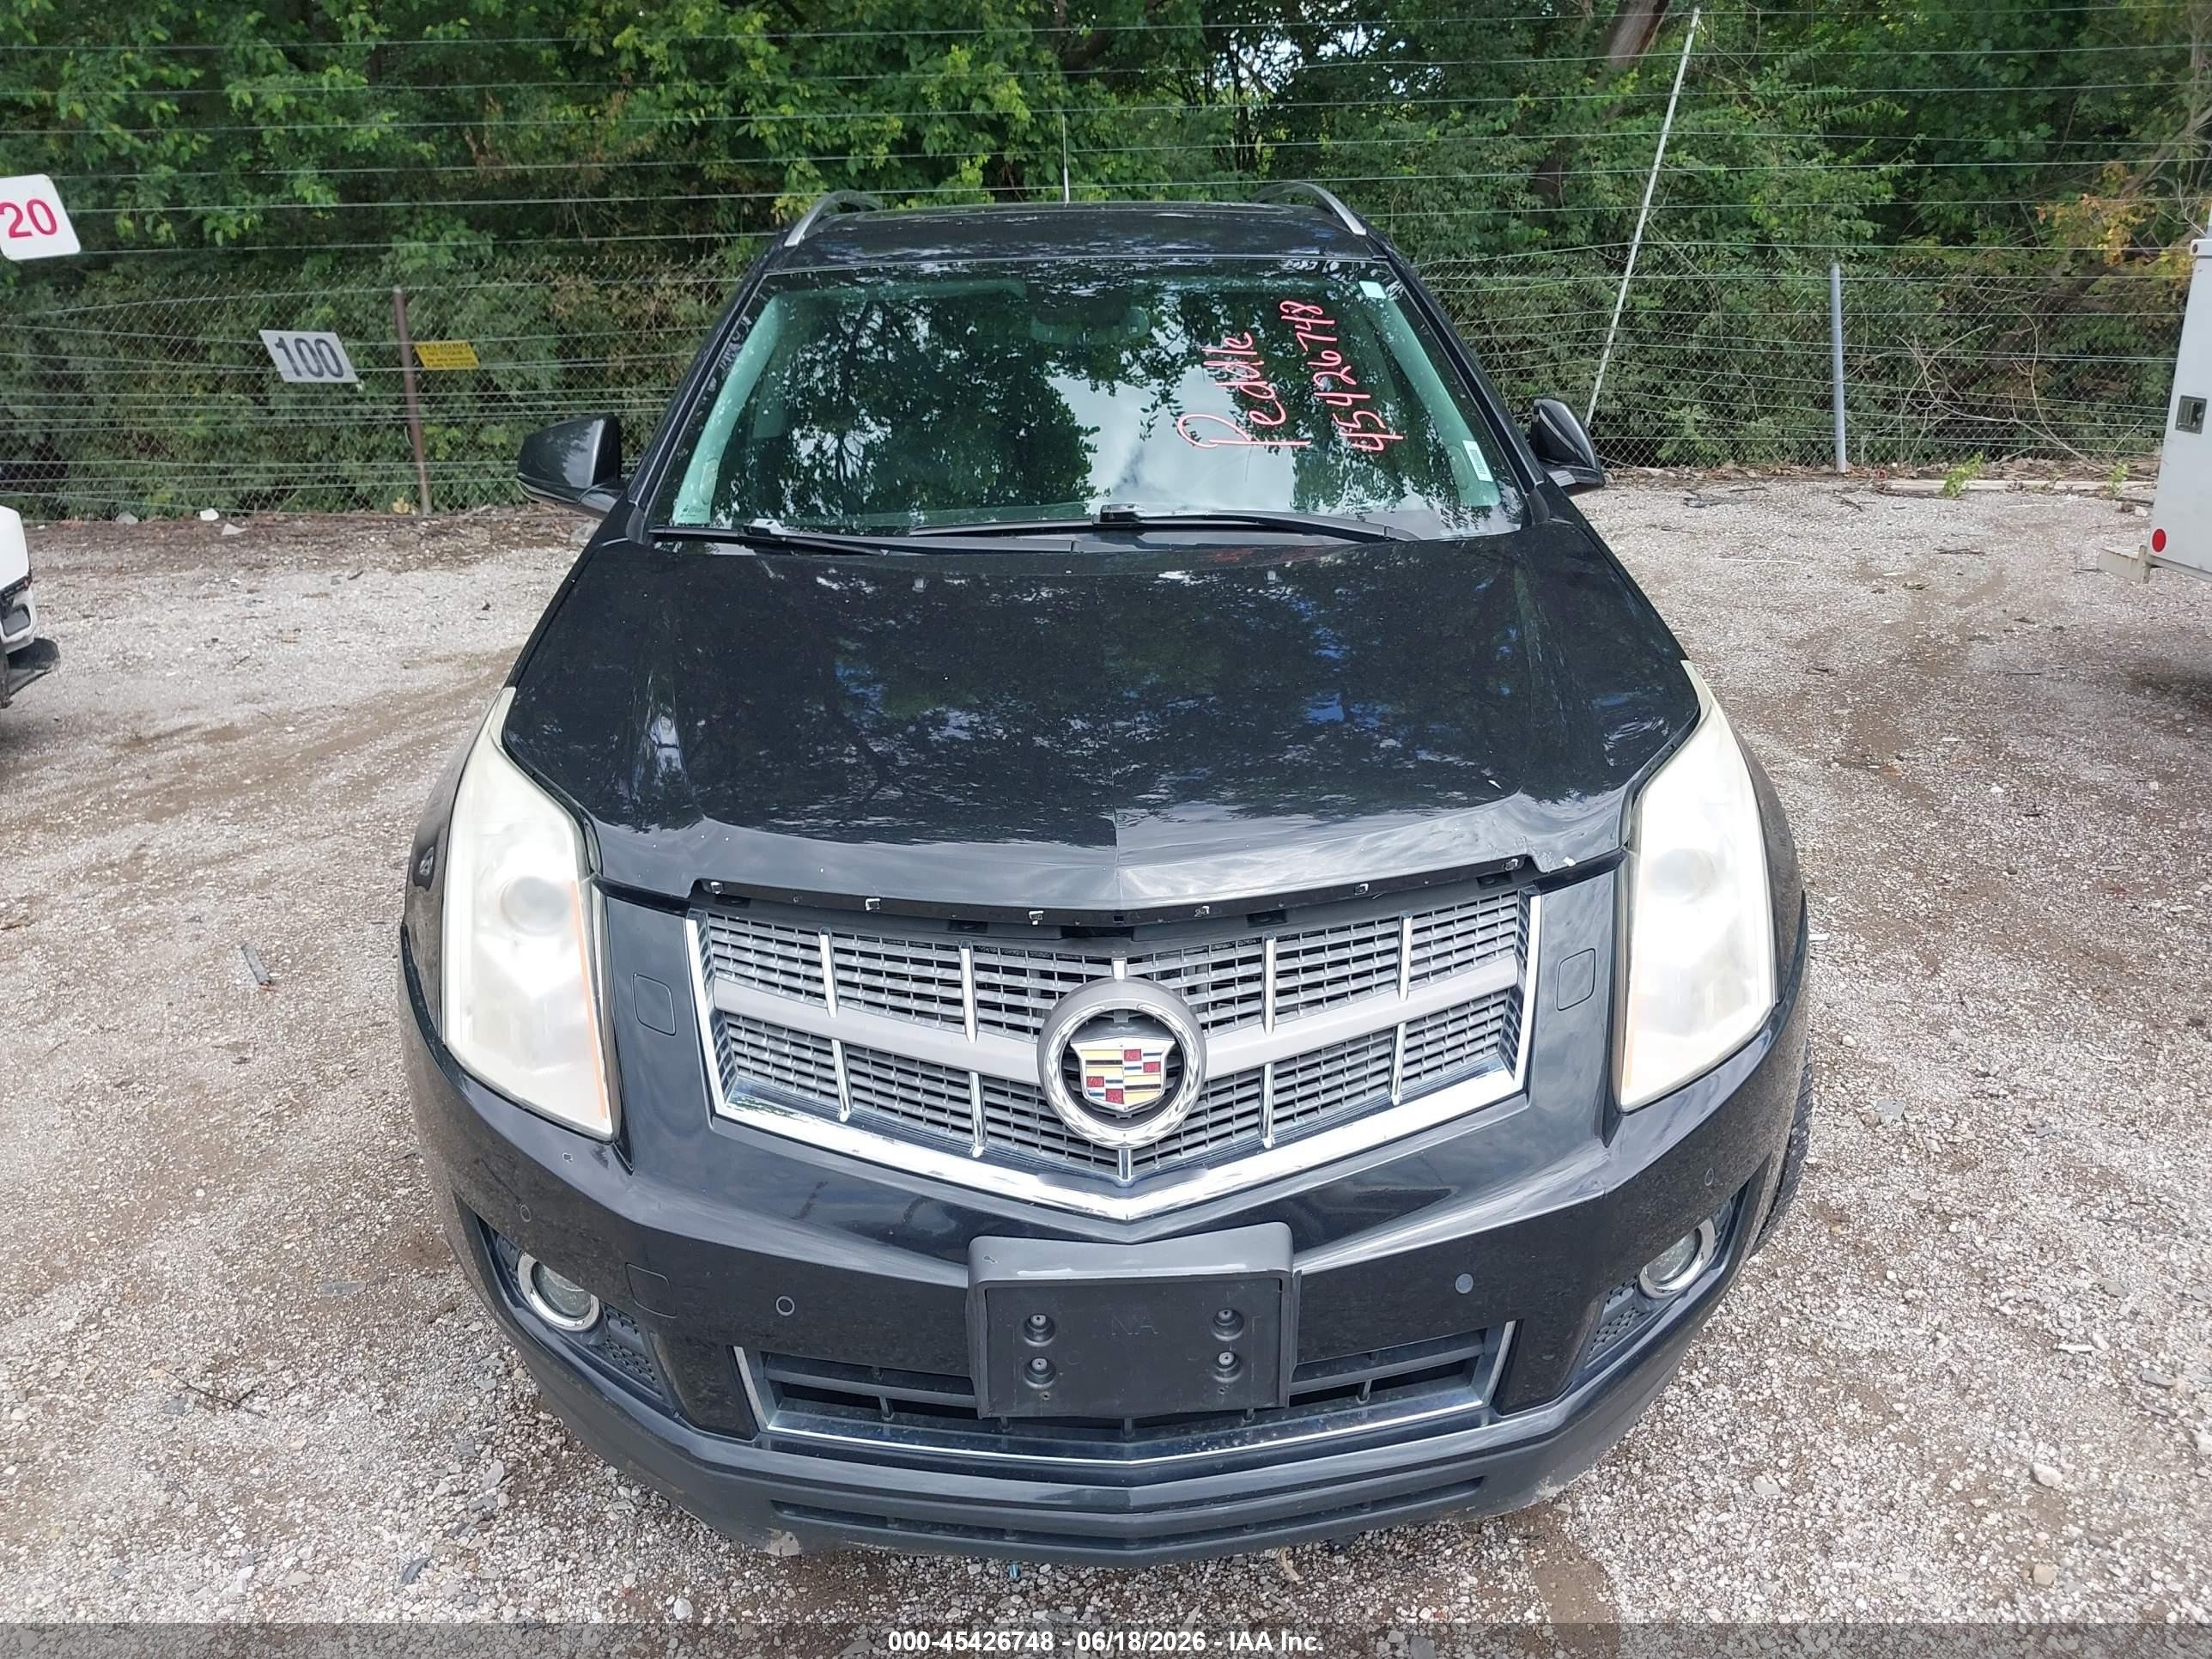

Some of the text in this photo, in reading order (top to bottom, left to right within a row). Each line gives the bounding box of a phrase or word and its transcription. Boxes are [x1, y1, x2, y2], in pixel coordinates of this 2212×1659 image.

[0, 198, 58, 239] 20
[274, 336, 344, 379] 100
[1176, 331, 1312, 449] Peddle
[1279, 300, 1405, 453] 45426748
